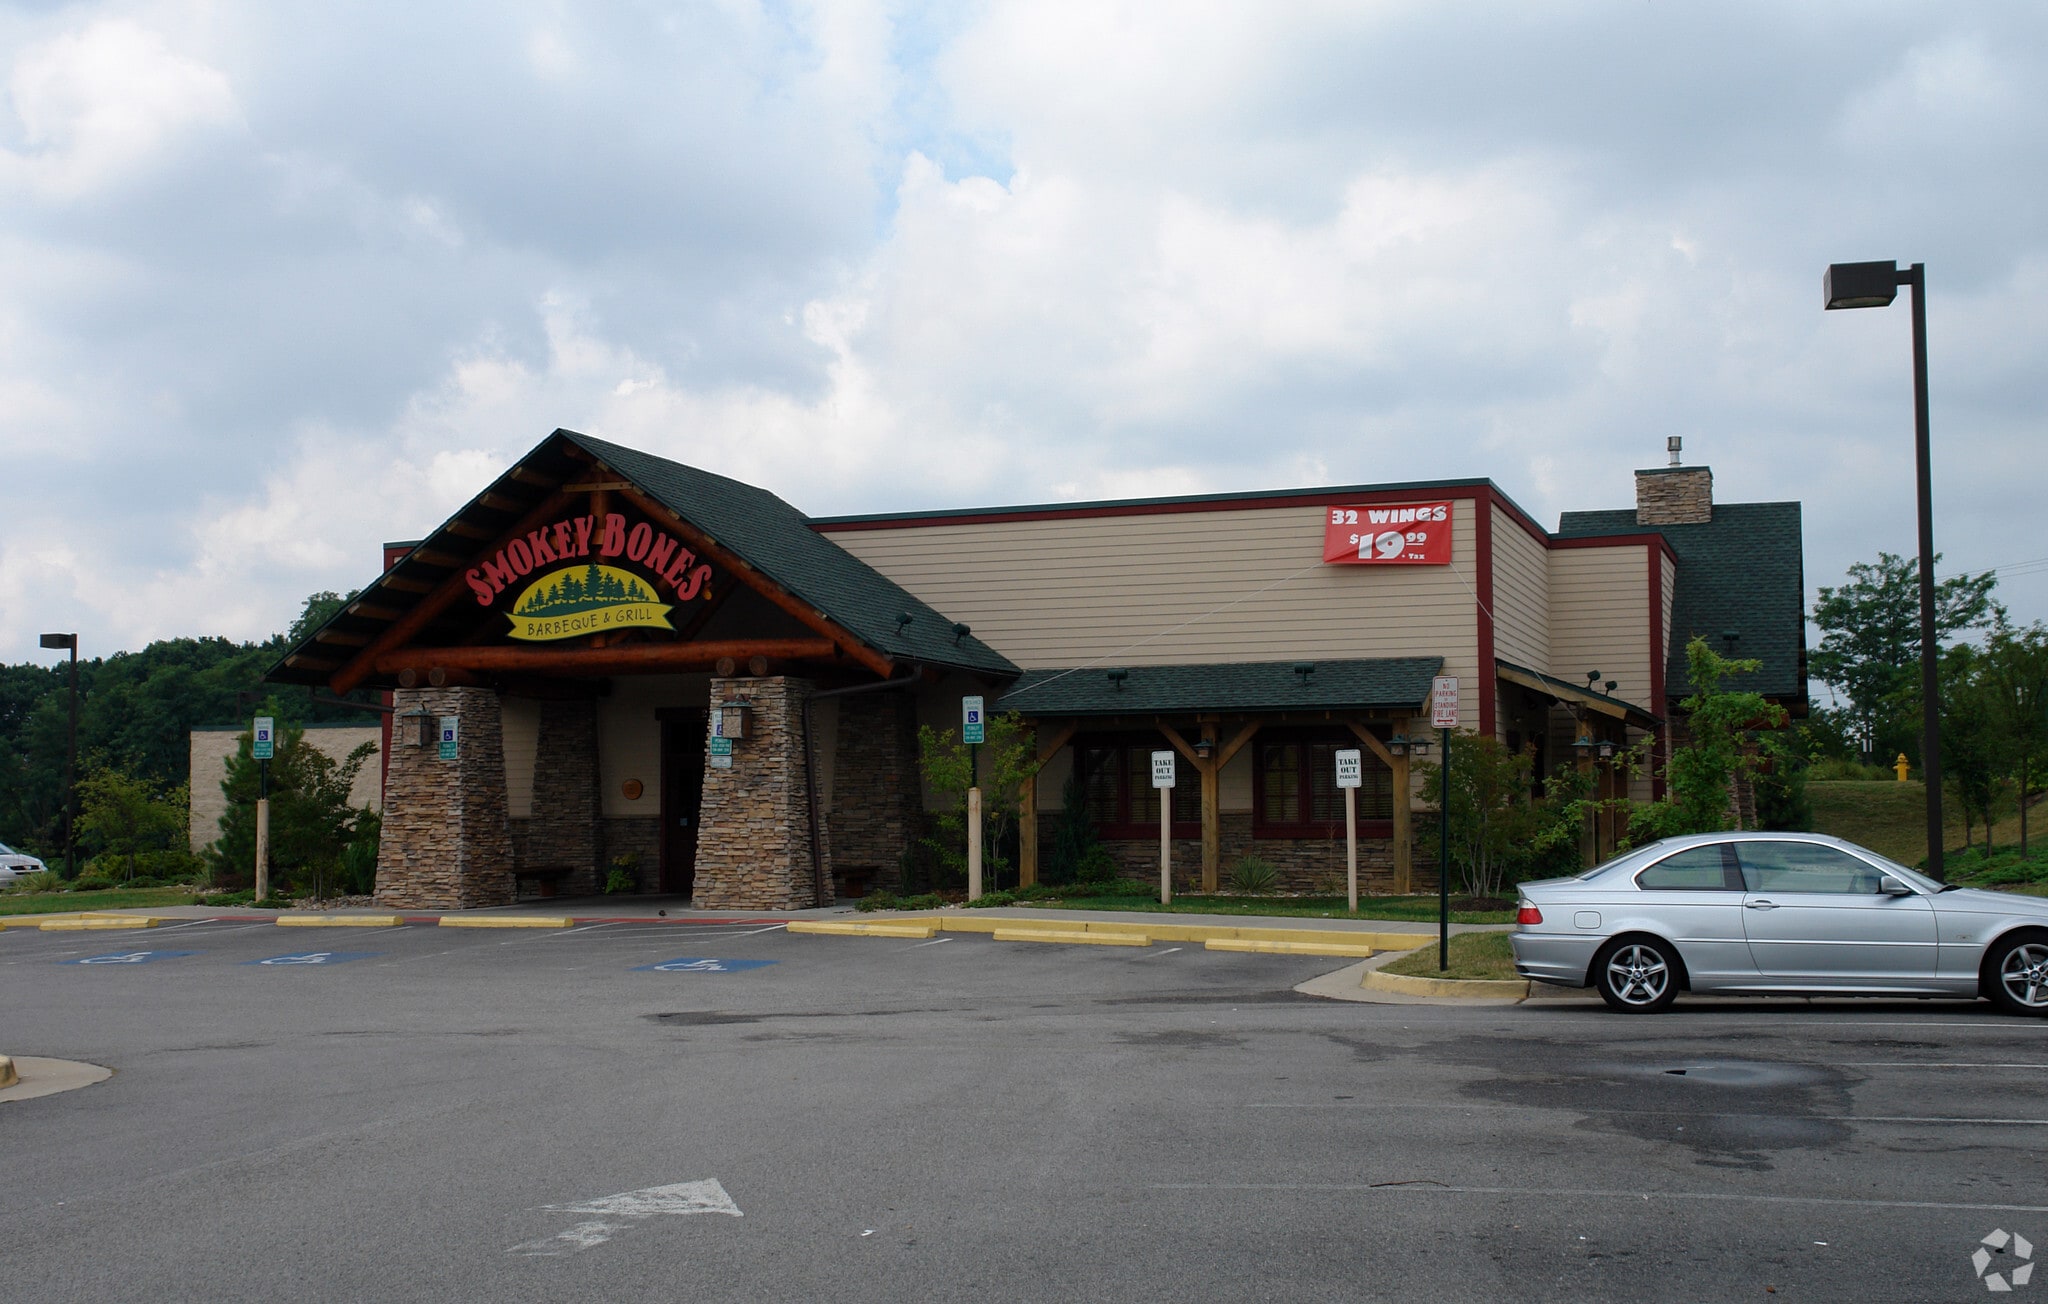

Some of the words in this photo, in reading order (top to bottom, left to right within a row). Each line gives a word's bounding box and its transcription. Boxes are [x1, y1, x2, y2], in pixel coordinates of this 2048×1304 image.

[1331, 510, 1358, 525] 32
[1368, 506, 1447, 524] WINGS
[465, 514, 594, 606] SMOKEY
[600, 513, 712, 601] BONES
[528, 613, 597, 635] BARBEQUE
[602, 610, 610, 623] &
[616, 608, 652, 623] GRILL
